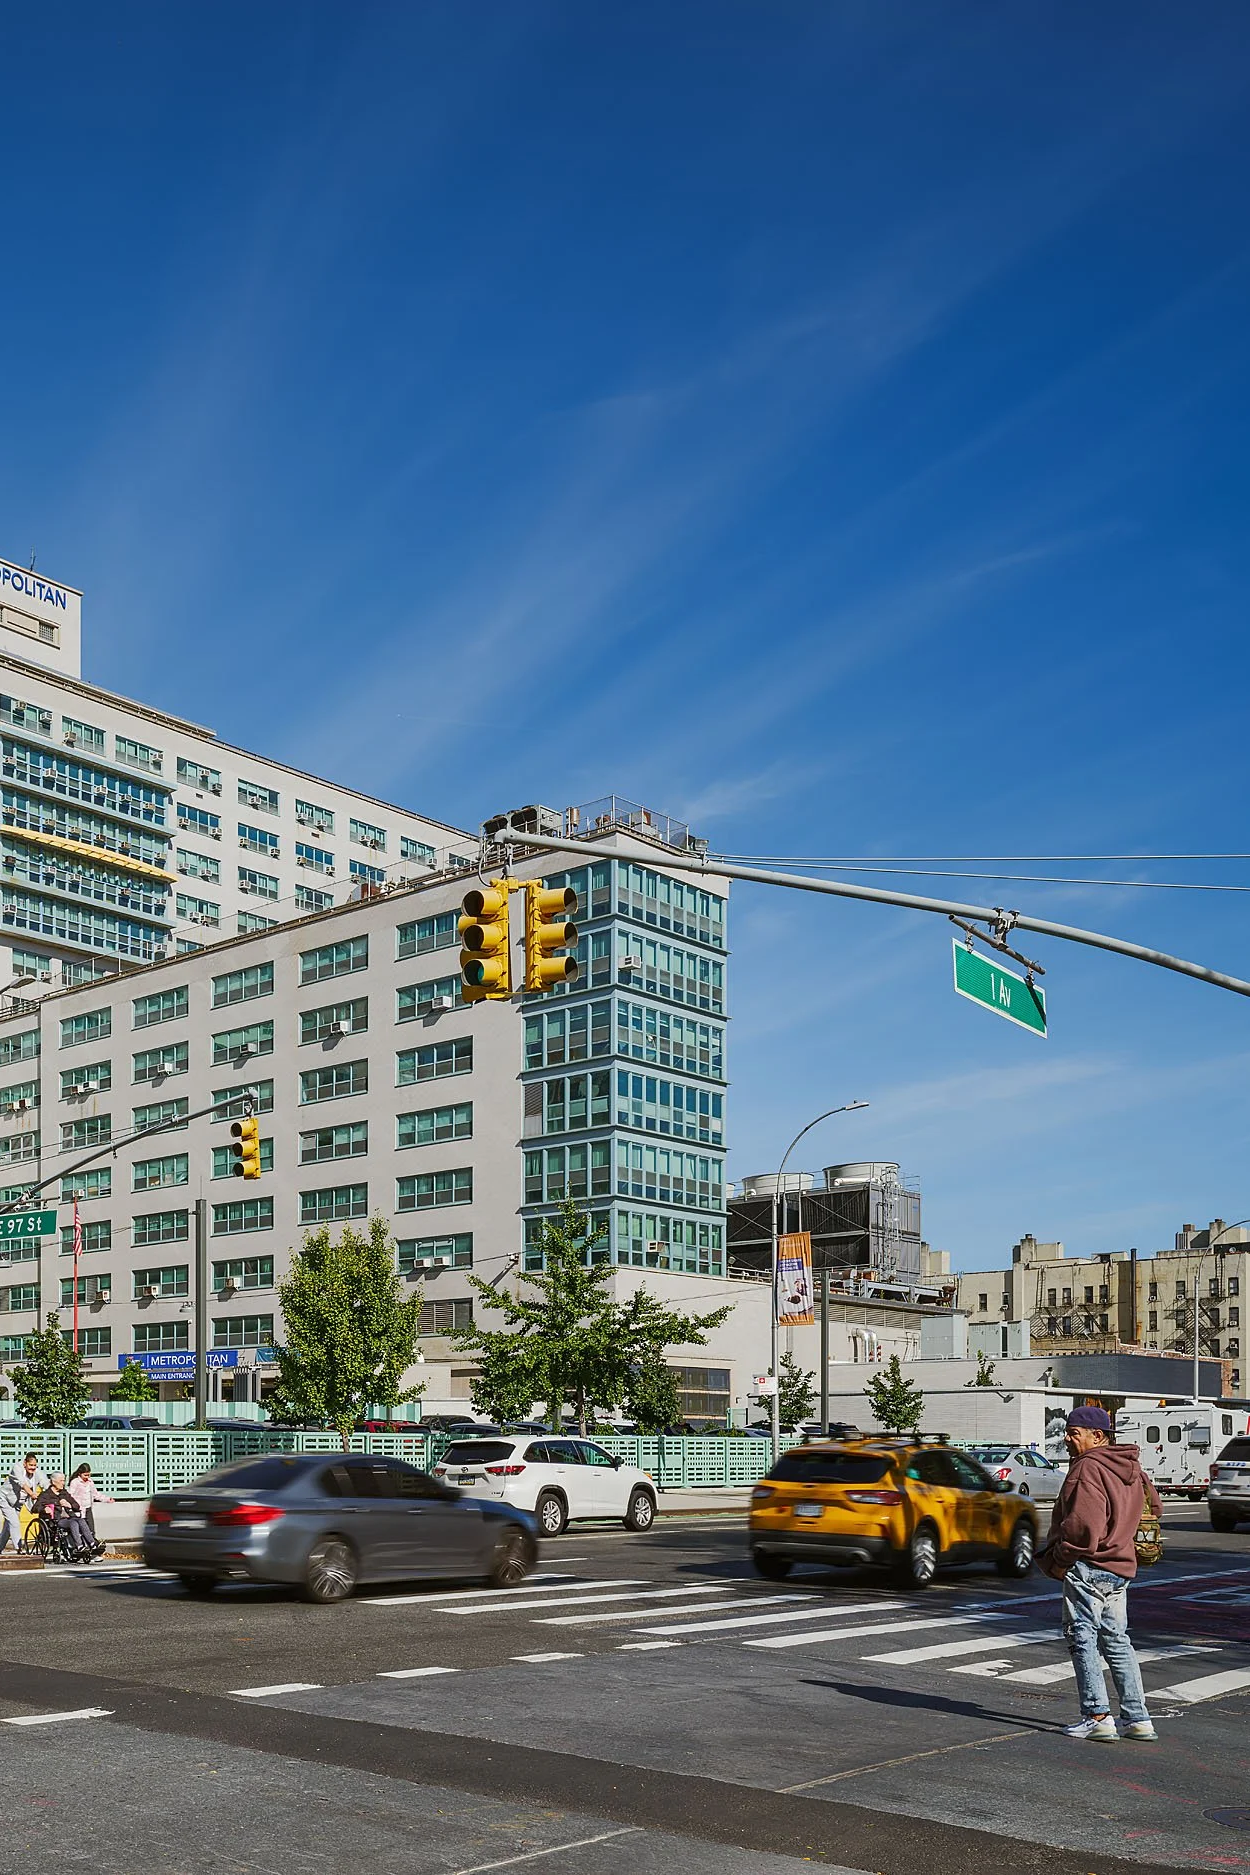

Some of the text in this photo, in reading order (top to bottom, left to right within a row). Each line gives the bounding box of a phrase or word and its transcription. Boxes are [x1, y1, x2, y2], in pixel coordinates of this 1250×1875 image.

[999, 978, 1011, 1008] Av
[8, 1218, 24, 1234] 97
[27, 1216, 42, 1232] St
[151, 1354, 228, 1366] METROPOITAN
